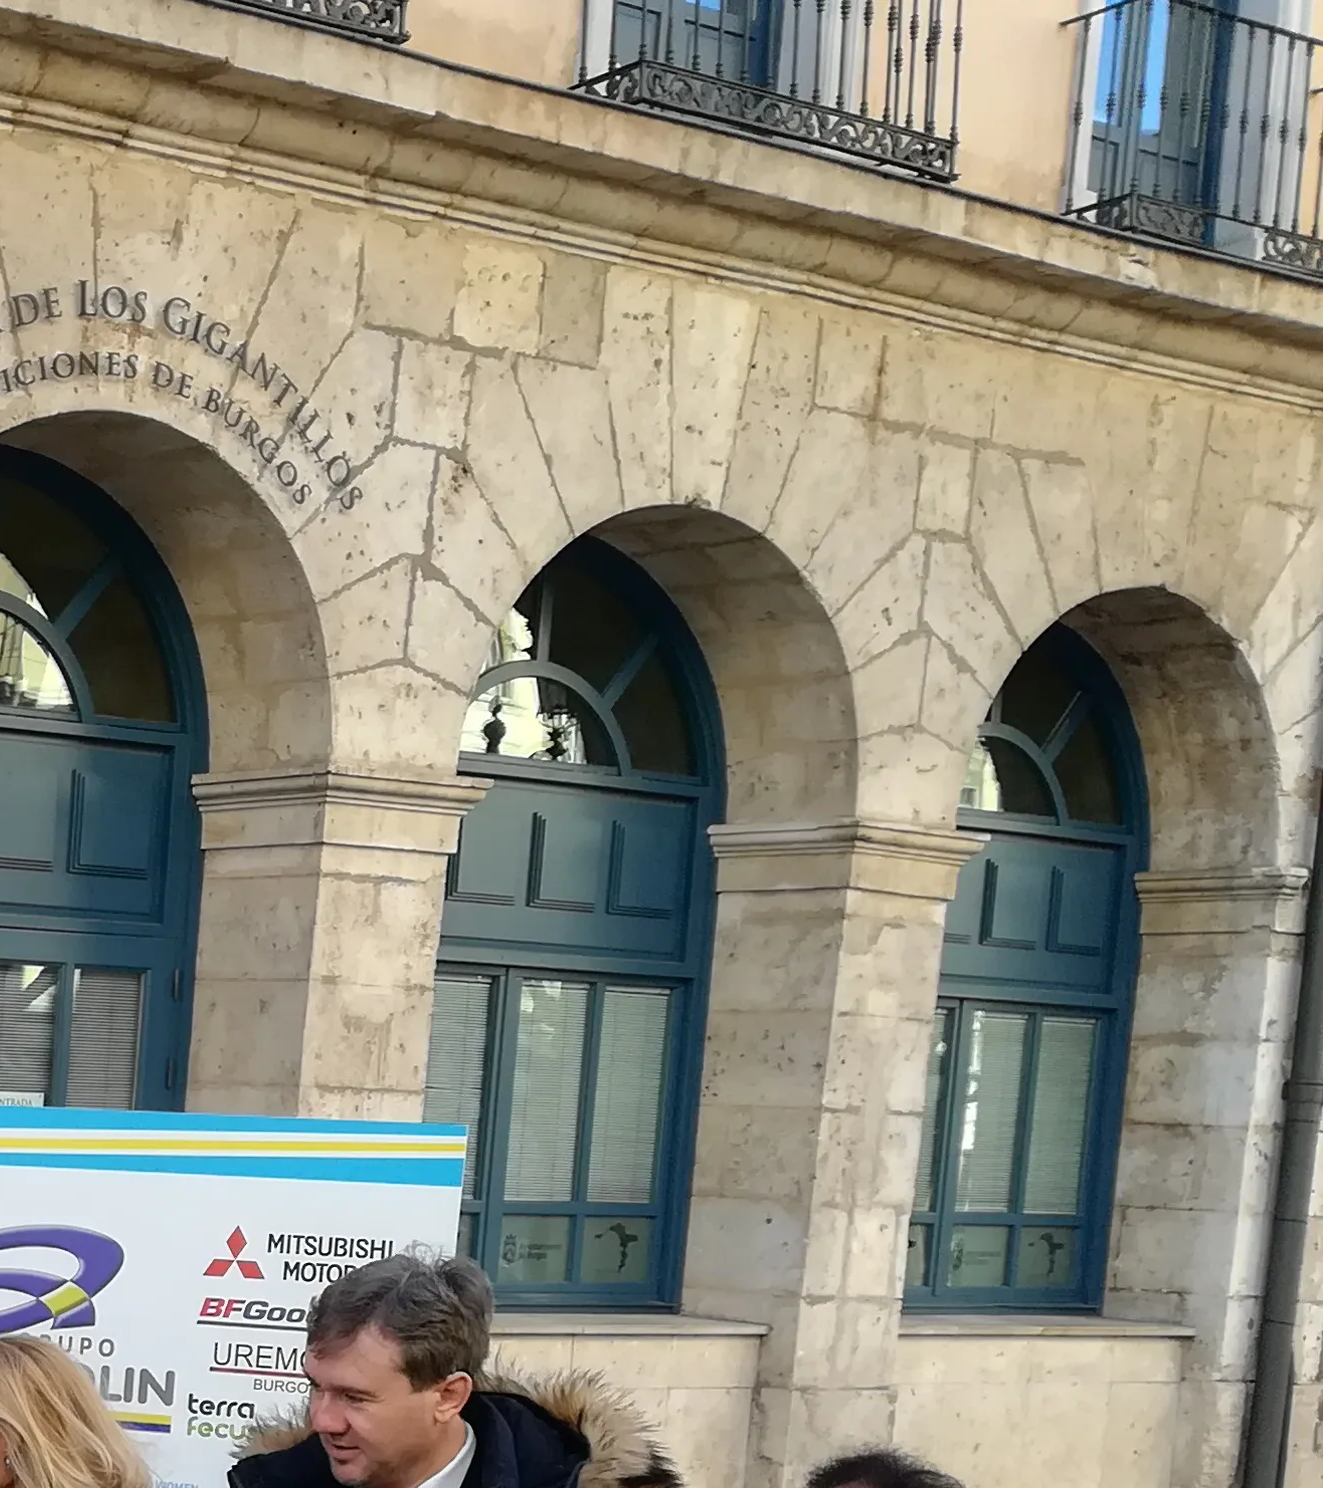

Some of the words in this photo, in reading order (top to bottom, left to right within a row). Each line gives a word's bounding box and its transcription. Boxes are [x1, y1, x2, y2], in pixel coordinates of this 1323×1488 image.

[10, 287, 63, 328] DE
[78, 280, 148, 323] LOS
[162, 296, 364, 512] GIGANTILLOS
[151, 359, 194, 398] DE
[201, 386, 313, 505] BURGOS
[267, 1233, 394, 1260] MITSUBISHI
[199, 1297, 310, 1323] BFGoo
[213, 1342, 306, 1371] UREM
[253, 1379, 309, 1394] BURGO
[187, 1393, 256, 1419] terra
